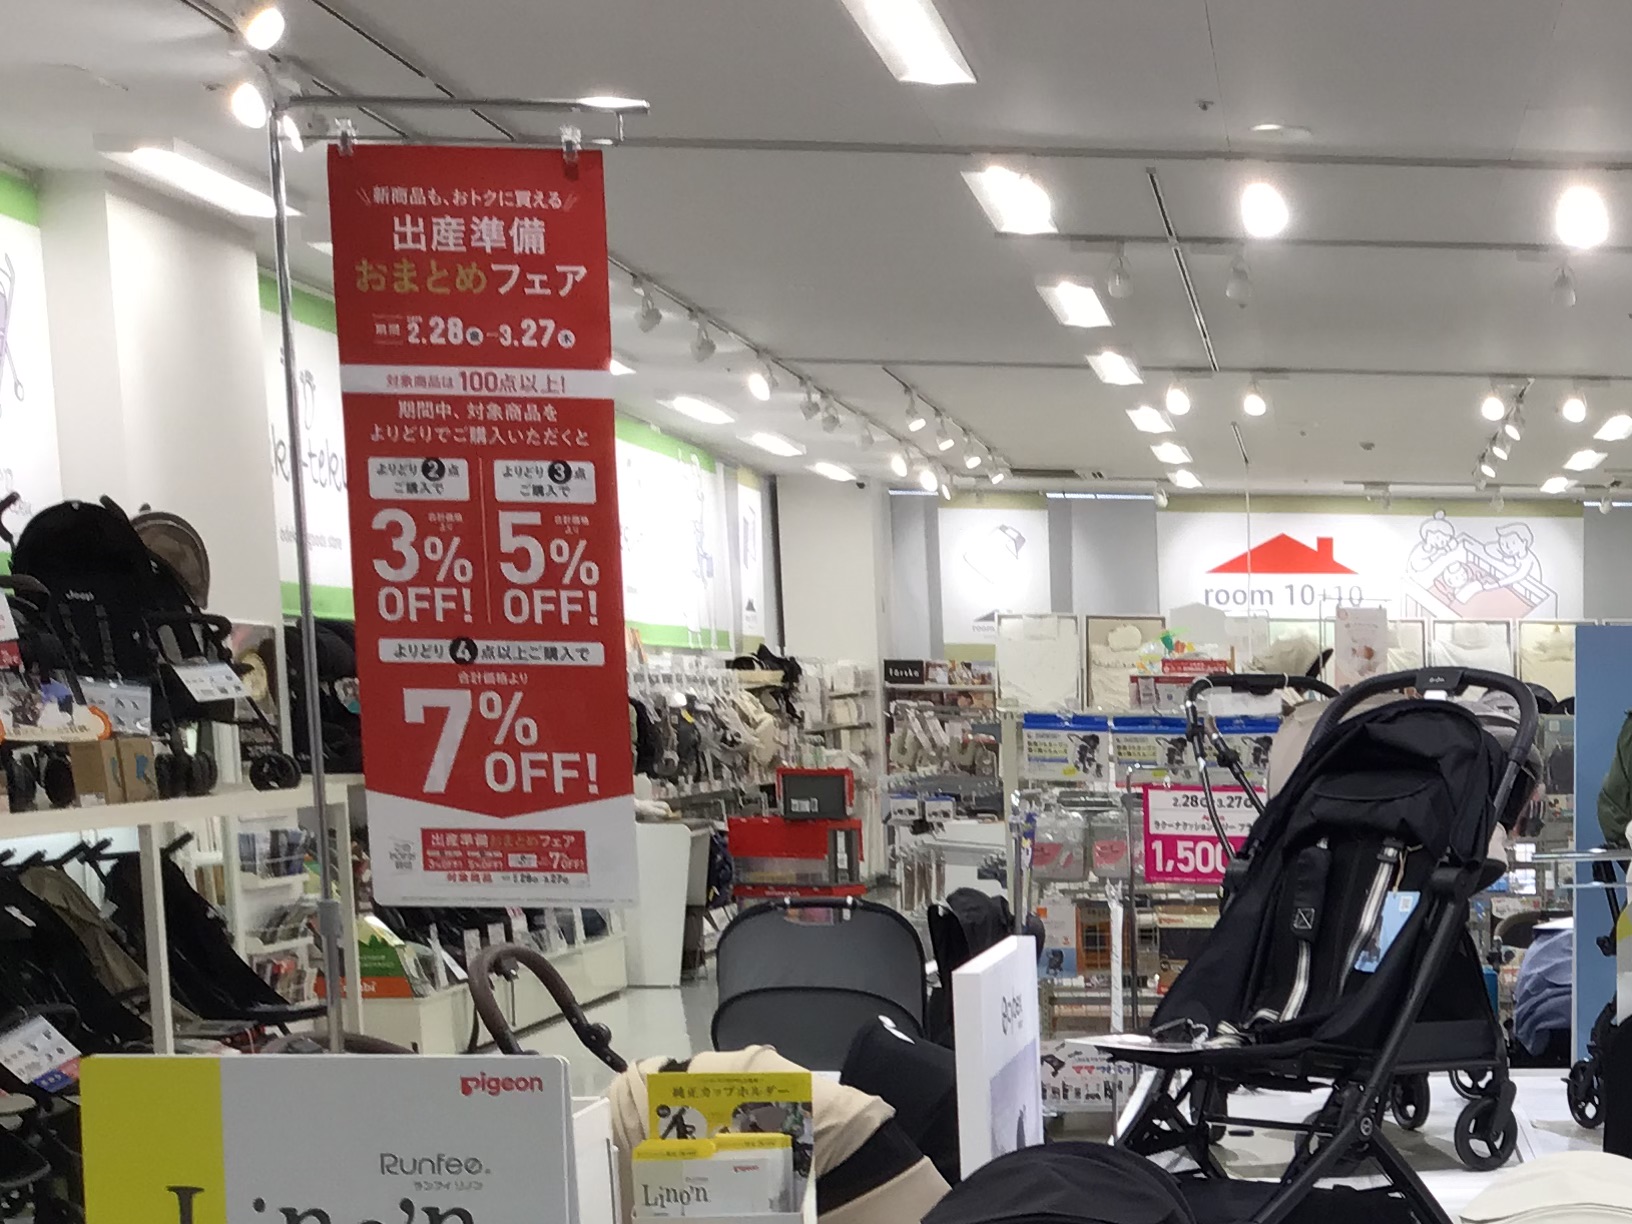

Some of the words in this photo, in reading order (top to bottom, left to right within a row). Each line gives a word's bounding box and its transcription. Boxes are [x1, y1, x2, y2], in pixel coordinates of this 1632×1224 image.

[373, 185, 563, 210] 新商品も、おトクに買える
[393, 213, 546, 255] 出産準備
[355, 257, 588, 297] おまとめフェア
[398, 400, 558, 422] 期間中、対象商品を
[370, 423, 589, 447] よりどりでご購入いただくと
[377, 586, 473, 623] OFF!
[503, 588, 599, 626] OFF!
[1204, 587, 1274, 606] room
[484, 751, 599, 795] OFF!
[460, 1071, 544, 1097] pigeon
